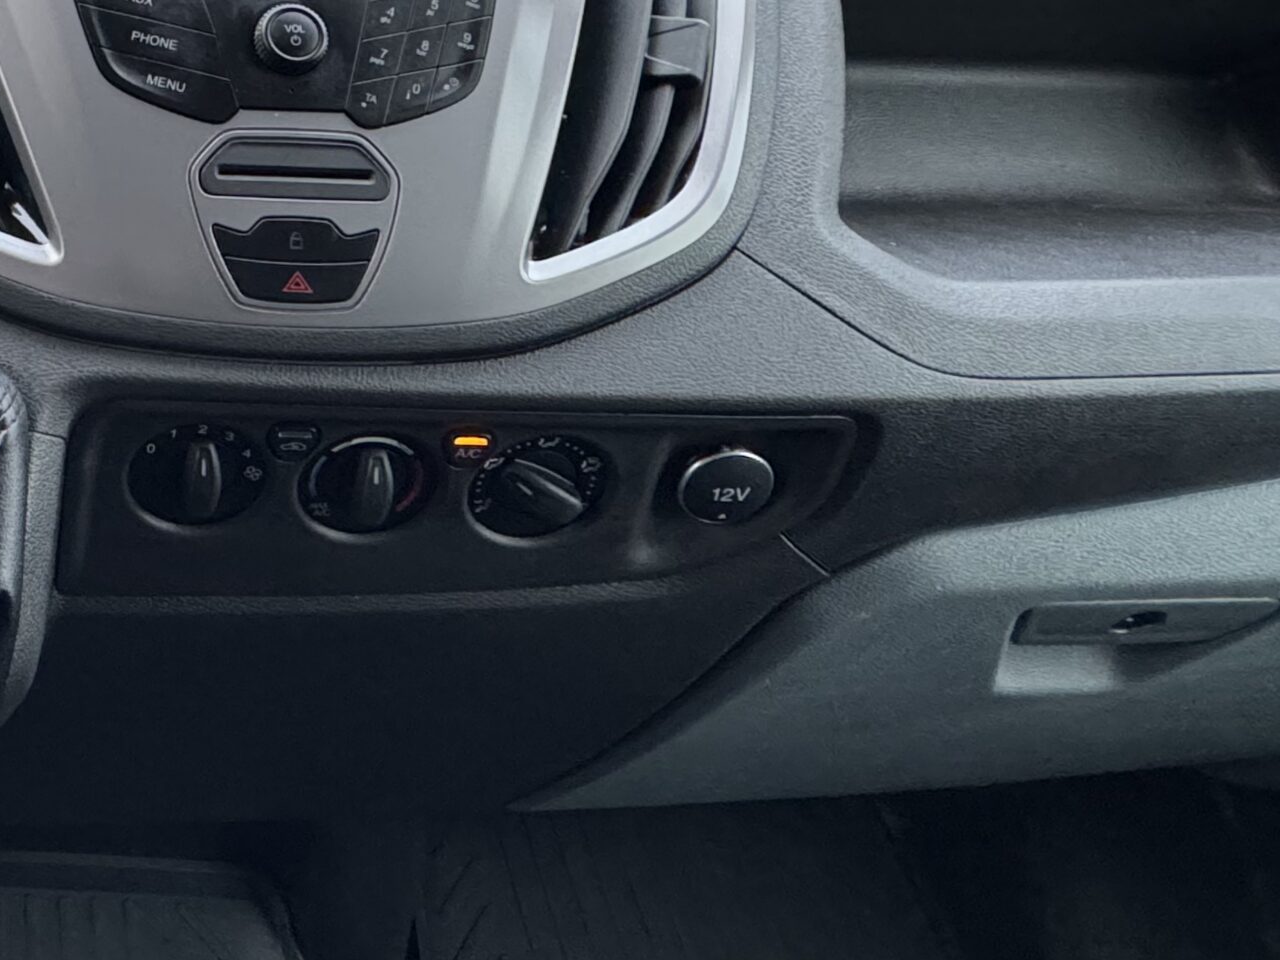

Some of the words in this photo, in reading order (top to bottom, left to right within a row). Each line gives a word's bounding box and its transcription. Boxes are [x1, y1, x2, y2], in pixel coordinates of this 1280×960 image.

[284, 23, 305, 34] VOL
[131, 30, 179, 51] PHONE
[146, 73, 186, 93] MENU
[198, 424, 208, 434] 2
[454, 448, 482, 459] A/C
[712, 487, 751, 502] 12V
